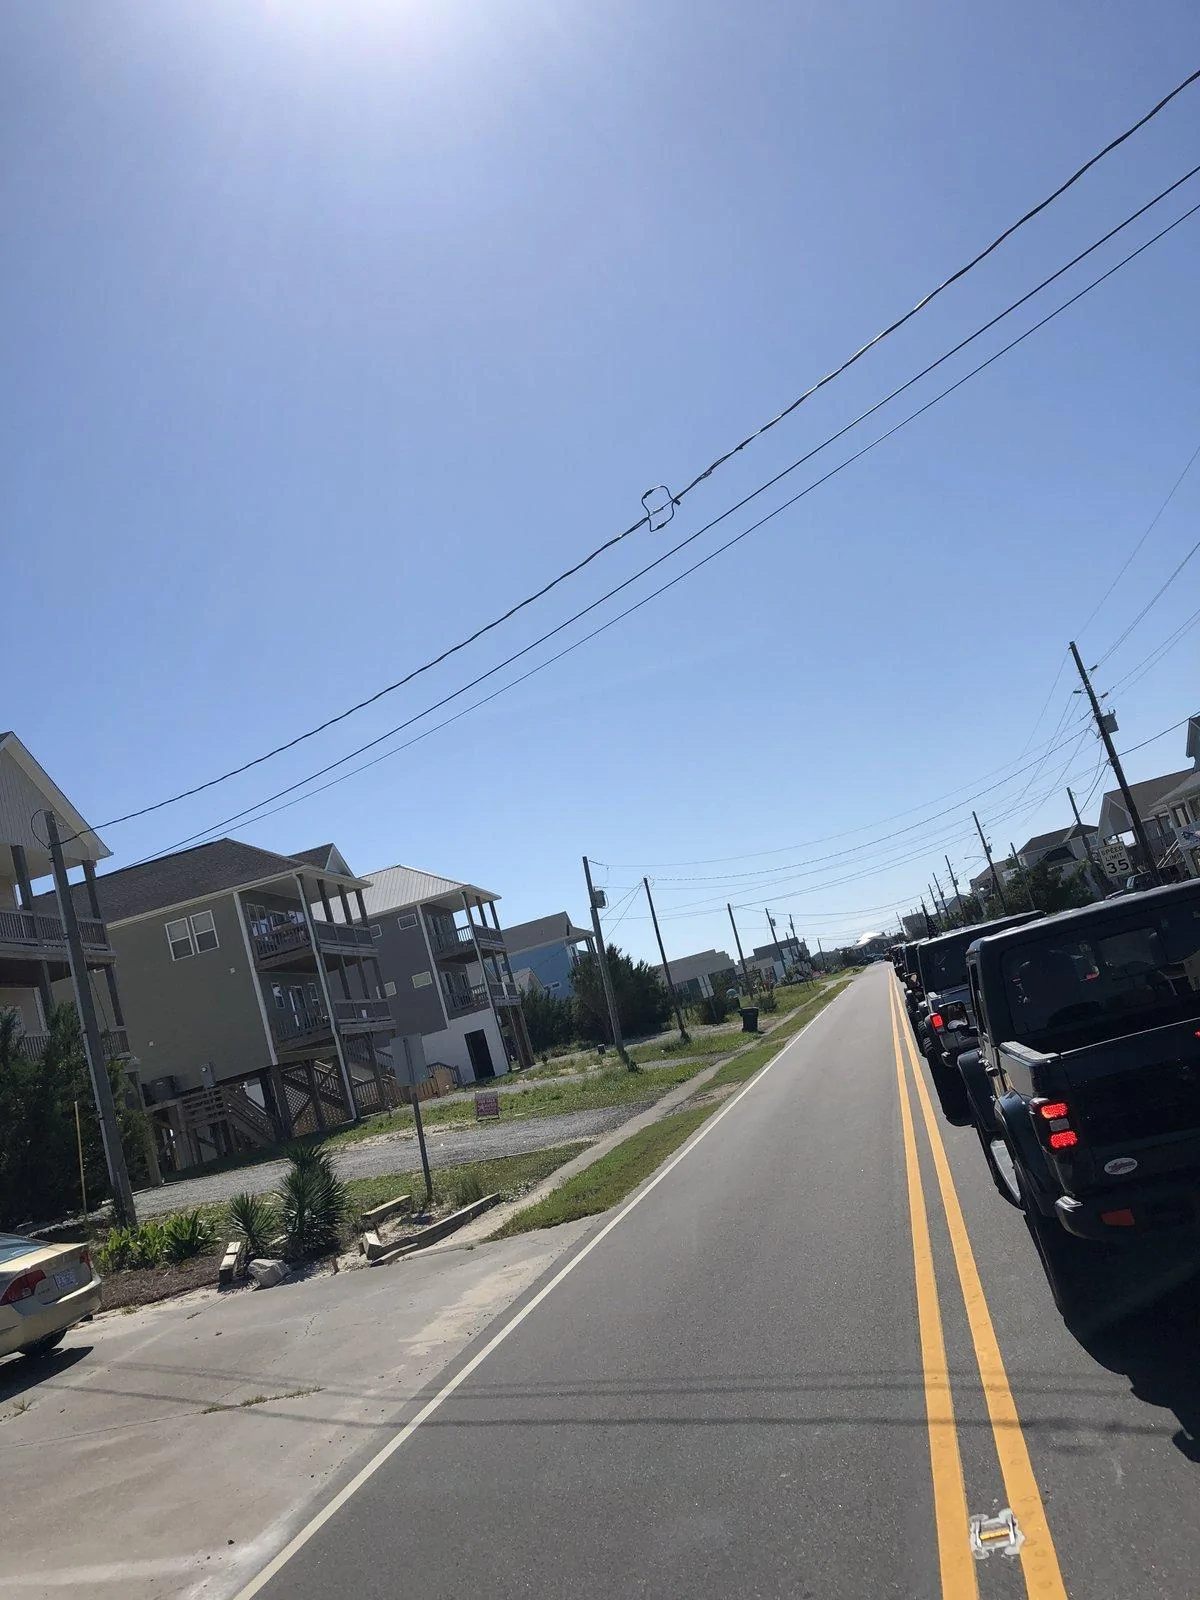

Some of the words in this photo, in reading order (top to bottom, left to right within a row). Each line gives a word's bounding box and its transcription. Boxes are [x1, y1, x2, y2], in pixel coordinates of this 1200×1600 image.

[1101, 845, 1124, 856] SPEED
[1105, 852, 1123, 861] LIMIT
[1106, 859, 1129, 874] 35
